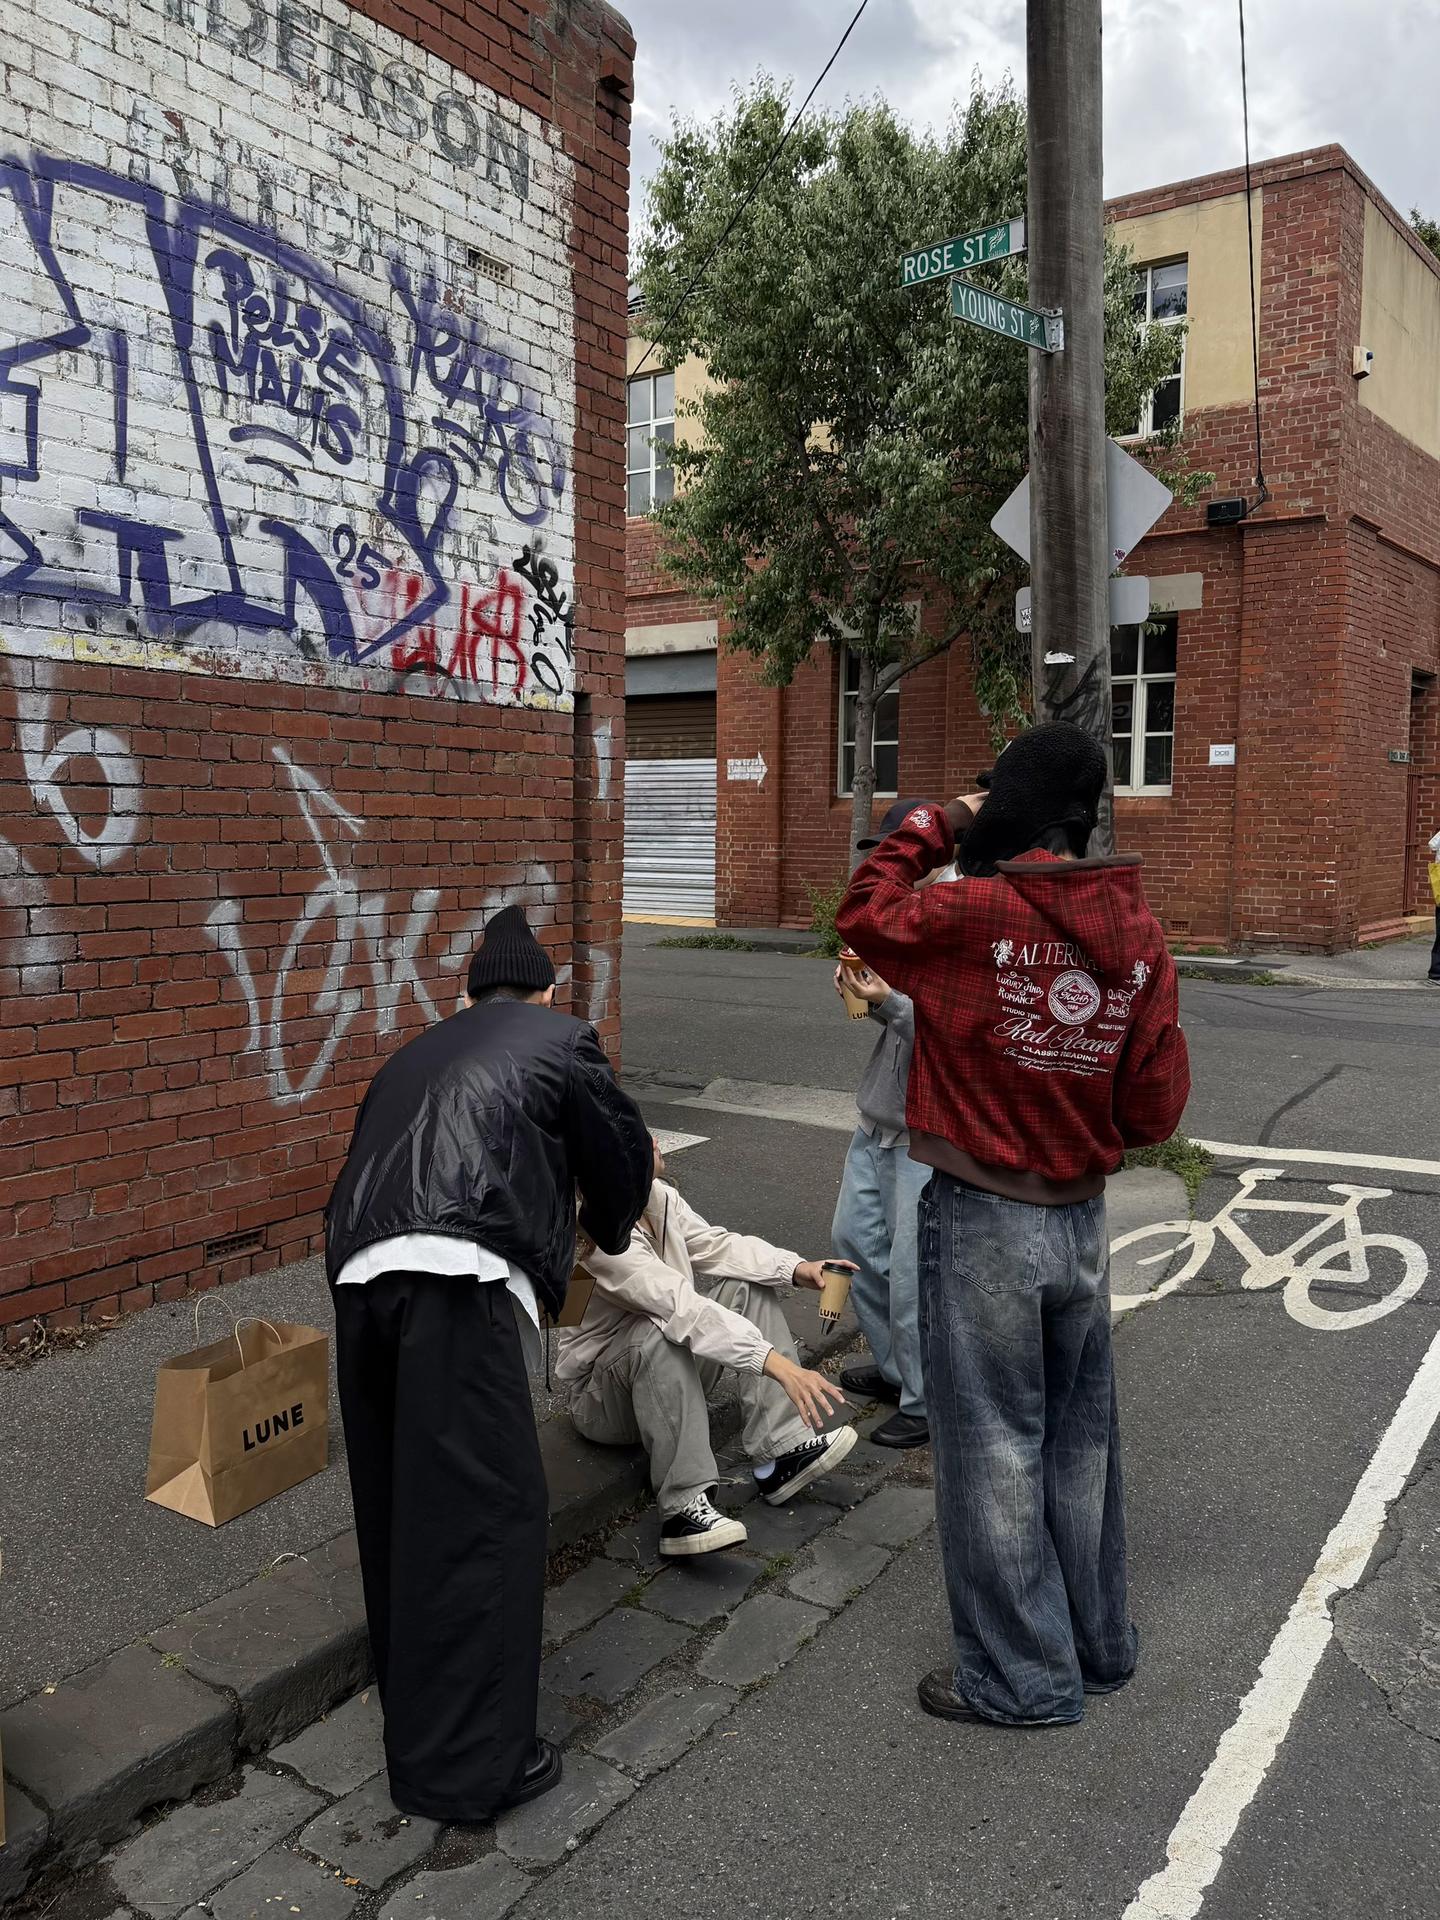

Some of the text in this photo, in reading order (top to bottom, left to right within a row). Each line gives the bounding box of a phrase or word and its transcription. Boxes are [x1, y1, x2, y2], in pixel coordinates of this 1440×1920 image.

[165, 0, 530, 199] DERSON
[904, 233, 987, 282] ROSE ST
[958, 285, 1025, 337] YOUNG ST
[332, 523, 392, 590] 25
[1014, 942, 1104, 973] ALTERN
[996, 972, 1024, 990] LUXURY
[998, 986, 1036, 1005] ROMANCE
[1001, 1005, 1025, 1016] STUDIO
[993, 1017, 1125, 1054] Red Record
[1022, 1045, 1059, 1057] CLASSIC
[820, 1308, 841, 1320] LUNE
[243, 1403, 304, 1452] LUNE
